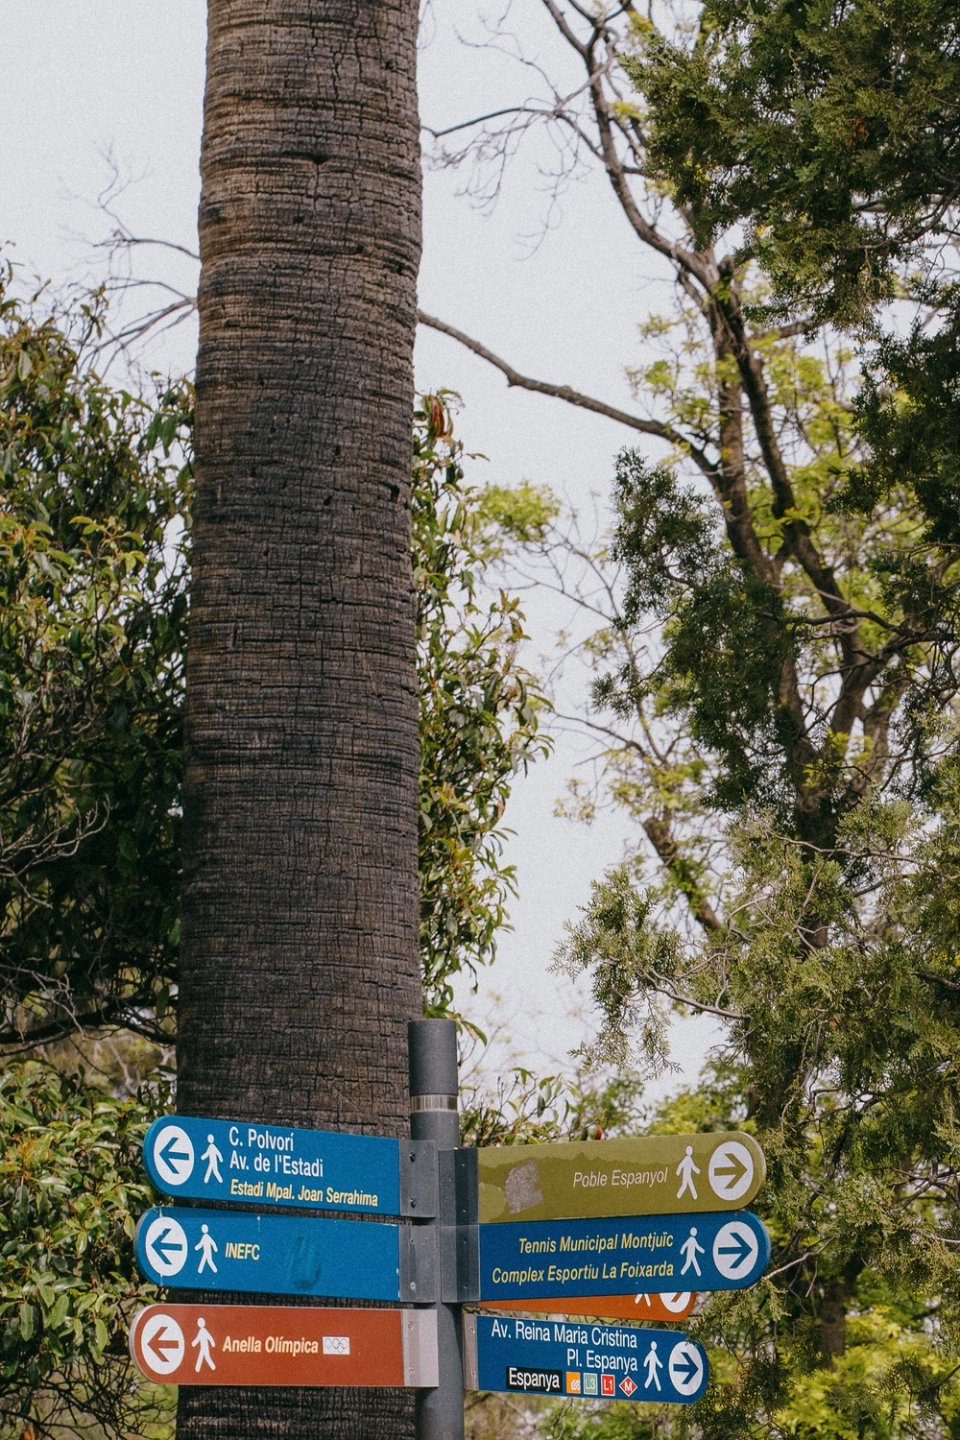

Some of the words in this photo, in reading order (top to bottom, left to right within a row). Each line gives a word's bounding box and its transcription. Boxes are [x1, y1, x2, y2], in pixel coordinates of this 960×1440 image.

[229, 1126, 243, 1147] C.
[248, 1128, 294, 1151] Polvorí
[229, 1150, 249, 1170] Av.
[254, 1153, 270, 1172] de
[275, 1155, 323, 1177] l'Estadi
[573, 1172, 608, 1188] Poble
[611, 1168, 668, 1188] Espanyol
[230, 1179, 263, 1197] Estadi
[266, 1182, 294, 1202] Mpal.
[297, 1185, 323, 1202] Joan
[326, 1187, 378, 1207] Serrahima
[225, 1243, 260, 1261] INEFC
[519, 1238, 556, 1254] Tennis
[559, 1234, 618, 1254] Municipal
[621, 1231, 674, 1251] Montjuïc
[492, 1266, 544, 1286] Complex
[547, 1265, 599, 1284] Esportiu
[602, 1263, 617, 1279] La
[620, 1261, 674, 1279] Foixarda
[491, 1319, 512, 1339] Av.
[515, 1321, 550, 1342] Reina
[554, 1324, 588, 1345] Maria
[591, 1327, 638, 1348] Cristina
[222, 1336, 262, 1353] Anella
[265, 1336, 319, 1357] Olímpica
[566, 1348, 582, 1367] Pl.
[586, 1350, 638, 1375] Espanya
[508, 1367, 560, 1392] Espanya
[585, 1376, 596, 1390] L3
[603, 1378, 613, 1391] L1
